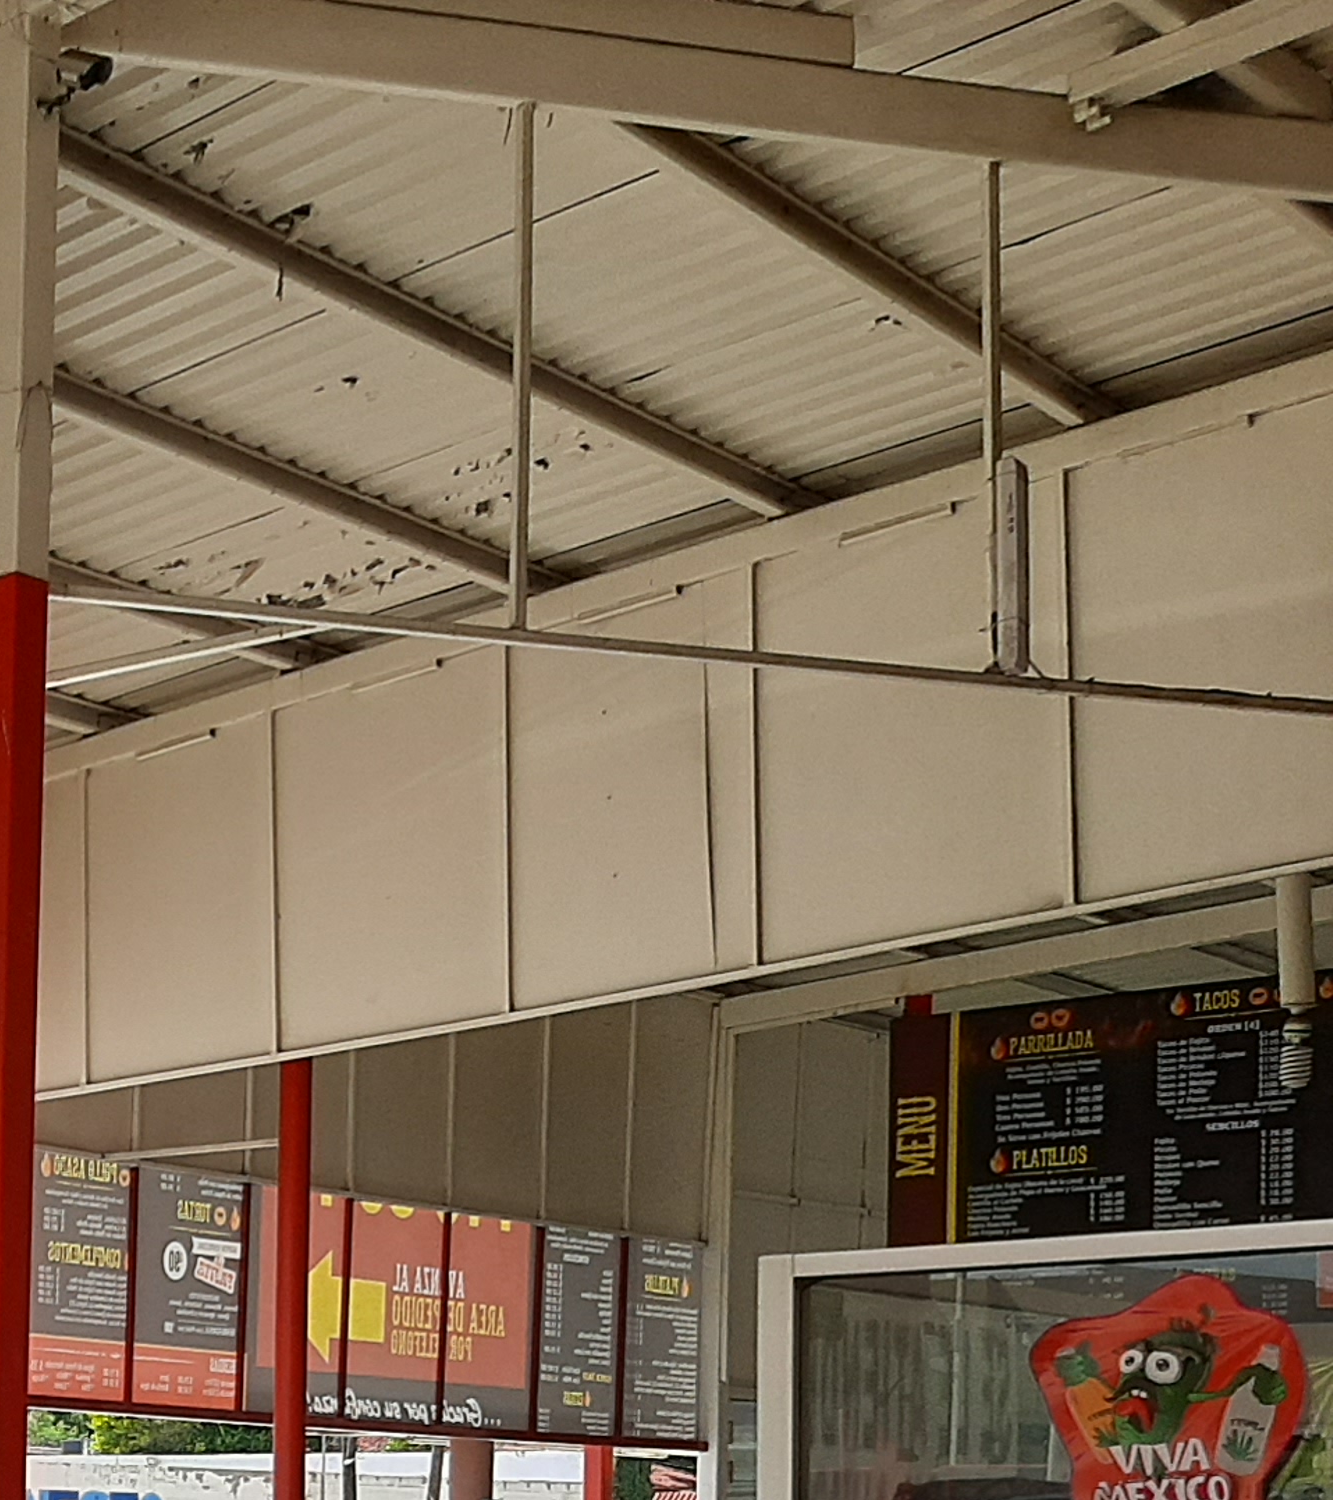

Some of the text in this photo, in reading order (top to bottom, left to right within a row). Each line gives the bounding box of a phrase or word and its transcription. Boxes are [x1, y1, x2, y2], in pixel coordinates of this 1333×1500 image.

[1193, 989, 1241, 1012] TACOS
[1008, 1029, 1094, 1057] PARRILLADA
[895, 1095, 937, 1178] MENU
[1012, 1145, 1088, 1171] PLATILLOS
[1108, 1438, 1211, 1477] VIVA
